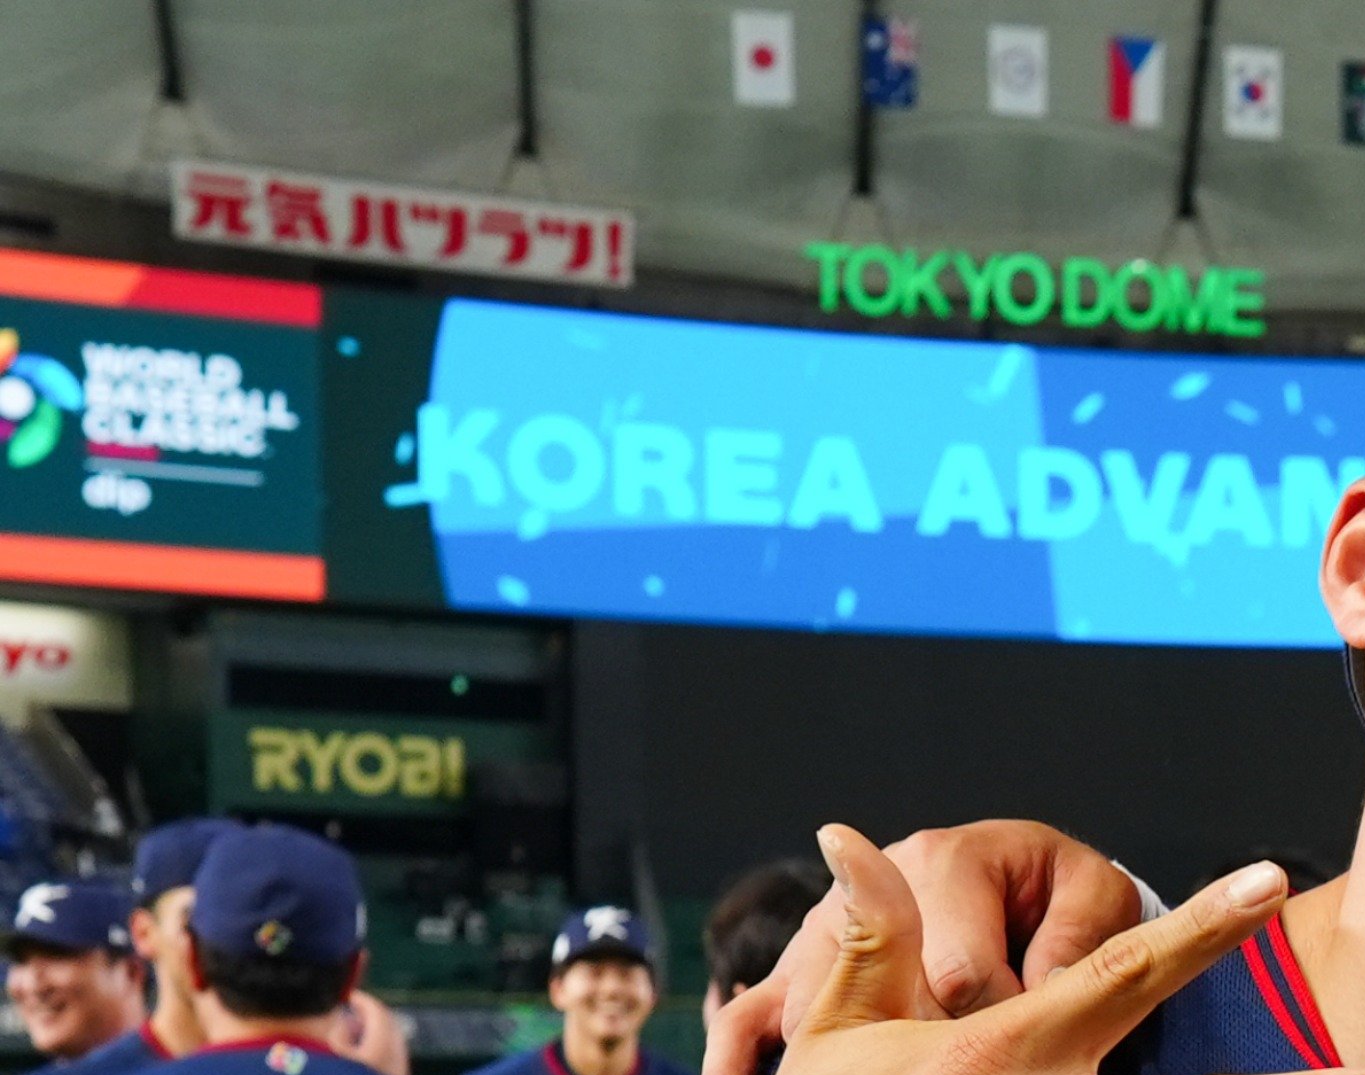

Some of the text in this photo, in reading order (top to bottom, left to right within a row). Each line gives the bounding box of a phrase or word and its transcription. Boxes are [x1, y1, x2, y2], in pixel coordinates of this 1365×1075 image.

[803, 240, 1267, 338] TOKYO DOME
[82, 341, 243, 391] WORLD
[83, 371, 299, 431] BASEBALL
[82, 406, 268, 459] CLASSIC
[82, 472, 152, 516] dip
[417, 403, 882, 533] KOREA
[248, 728, 466, 797] RYOBI
